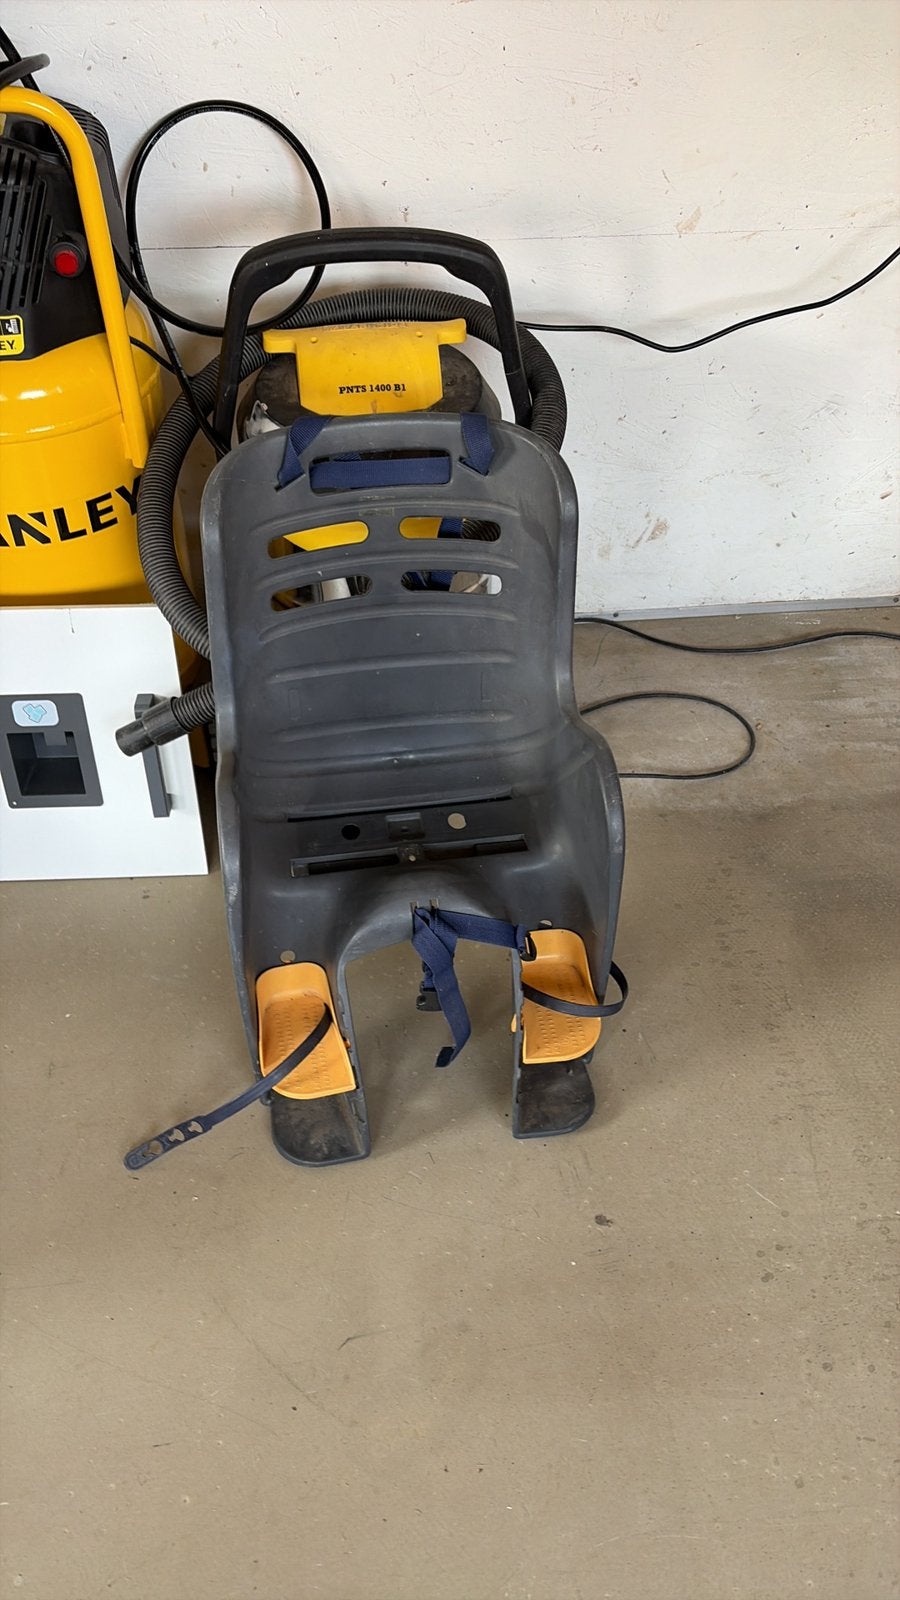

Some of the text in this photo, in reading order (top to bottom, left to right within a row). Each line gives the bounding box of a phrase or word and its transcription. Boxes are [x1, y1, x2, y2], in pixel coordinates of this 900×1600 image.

[338, 383, 407, 395] PNTS 1400 B1
